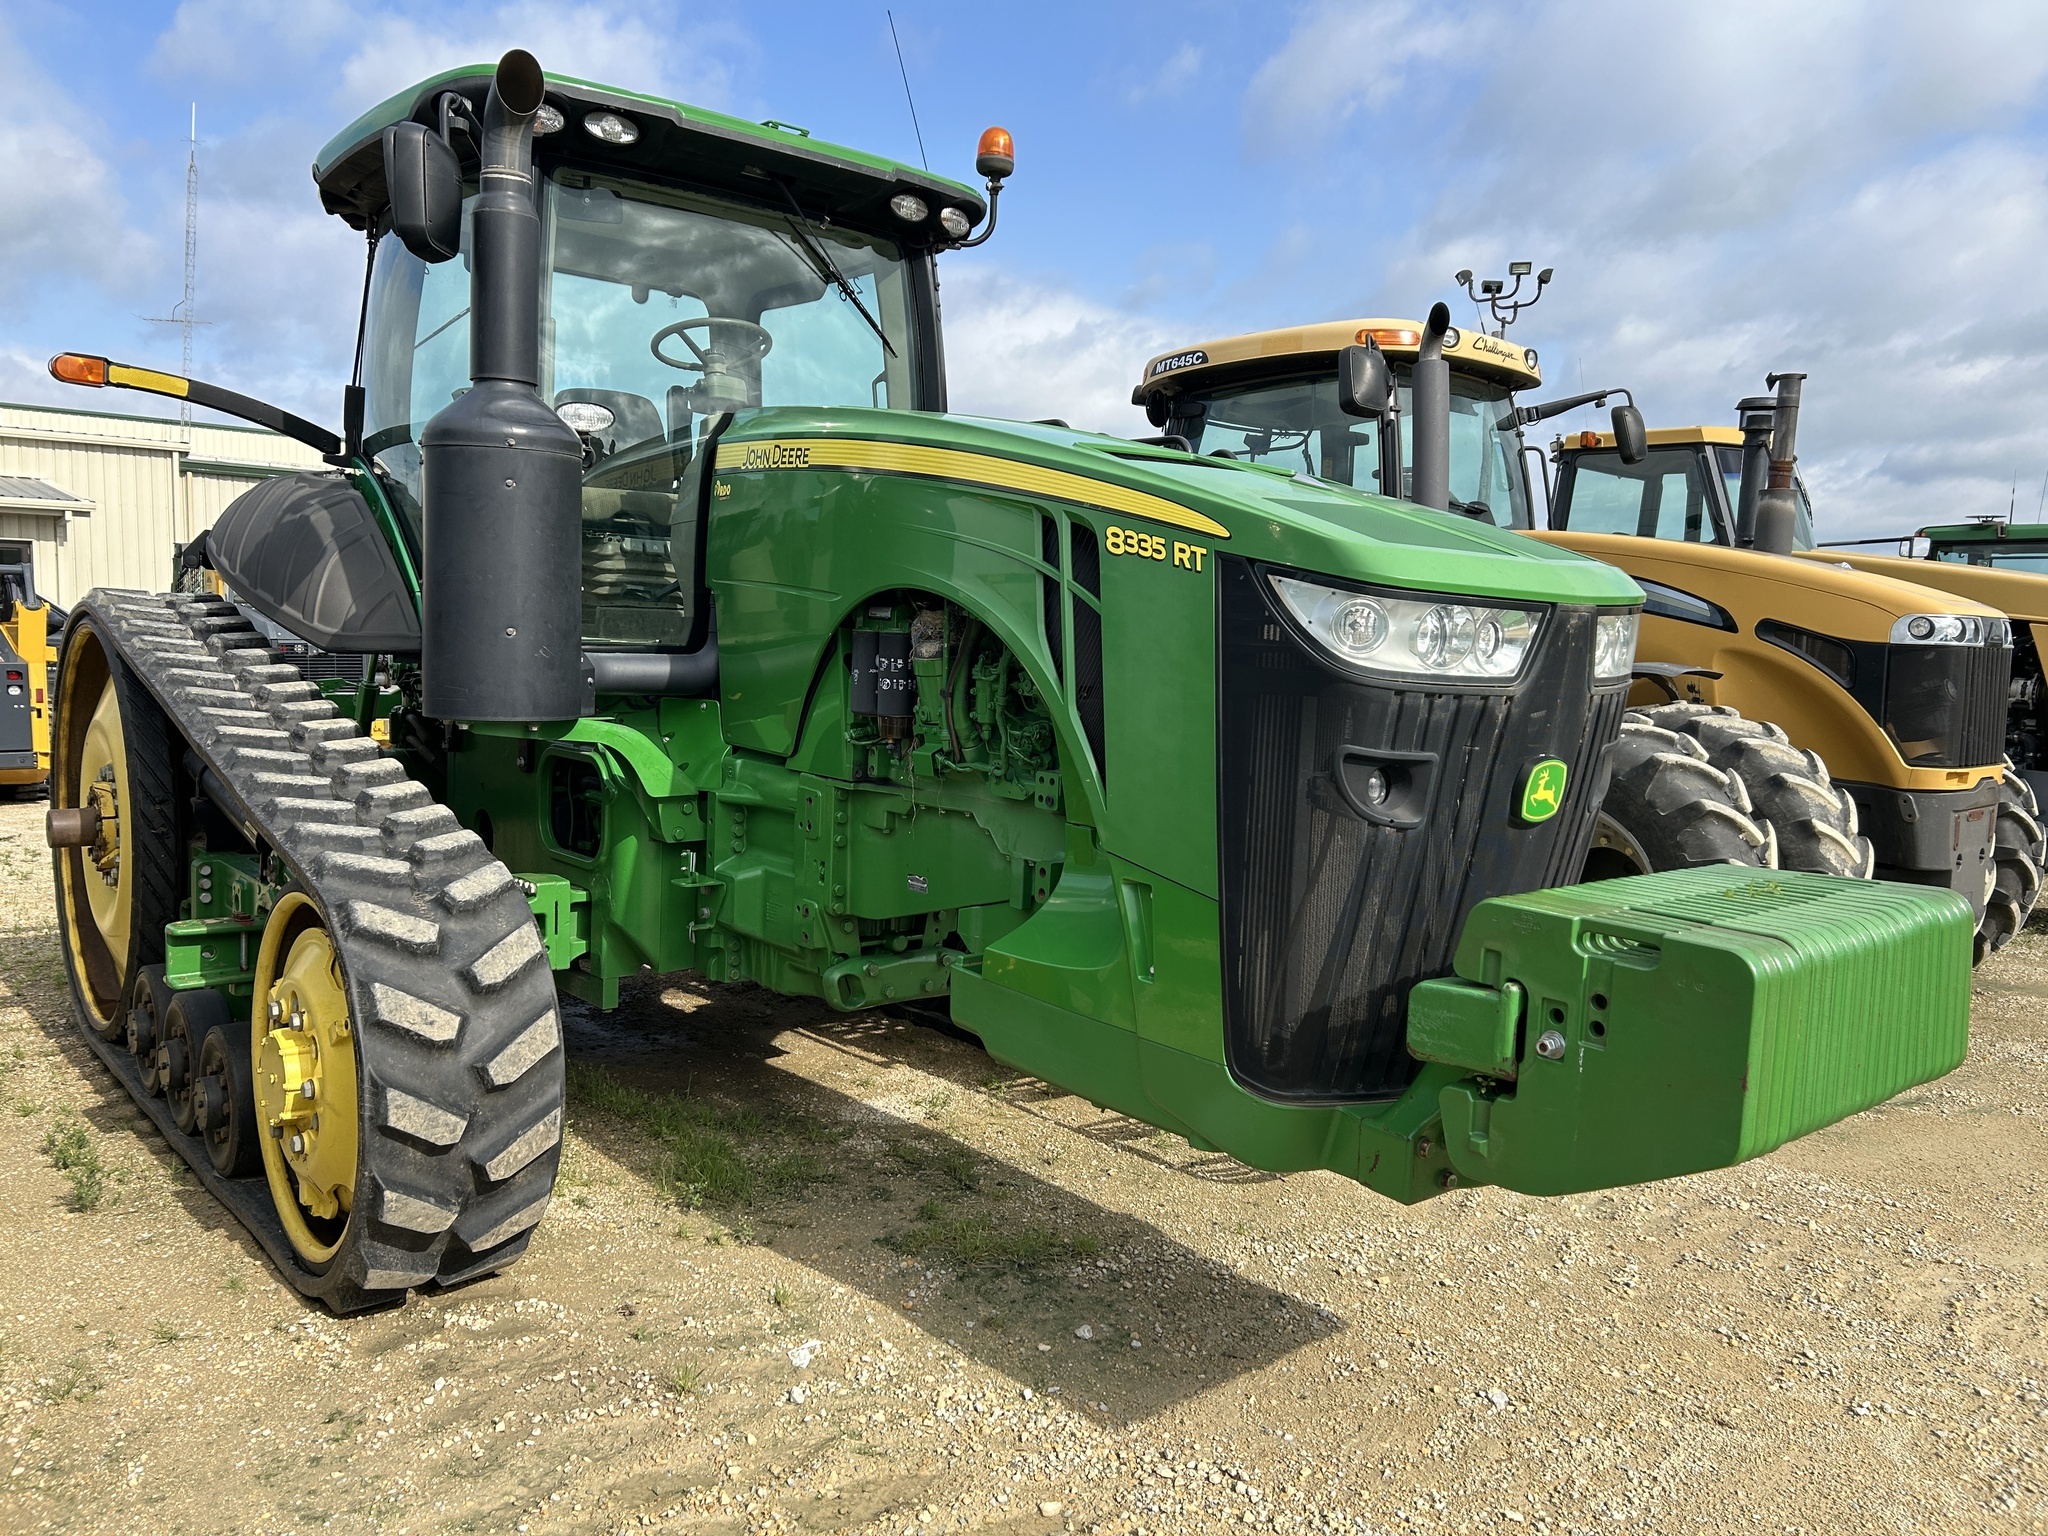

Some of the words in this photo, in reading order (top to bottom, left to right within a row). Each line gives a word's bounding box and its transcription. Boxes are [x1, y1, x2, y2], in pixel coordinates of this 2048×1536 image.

[1472, 336, 1519, 363] Challenger
[1155, 352, 1203, 374] MT645C
[742, 446, 771, 468] JOHN
[772, 444, 811, 467] DEERE
[1105, 525, 1167, 561] 8335
[1172, 541, 1207, 573] RT
